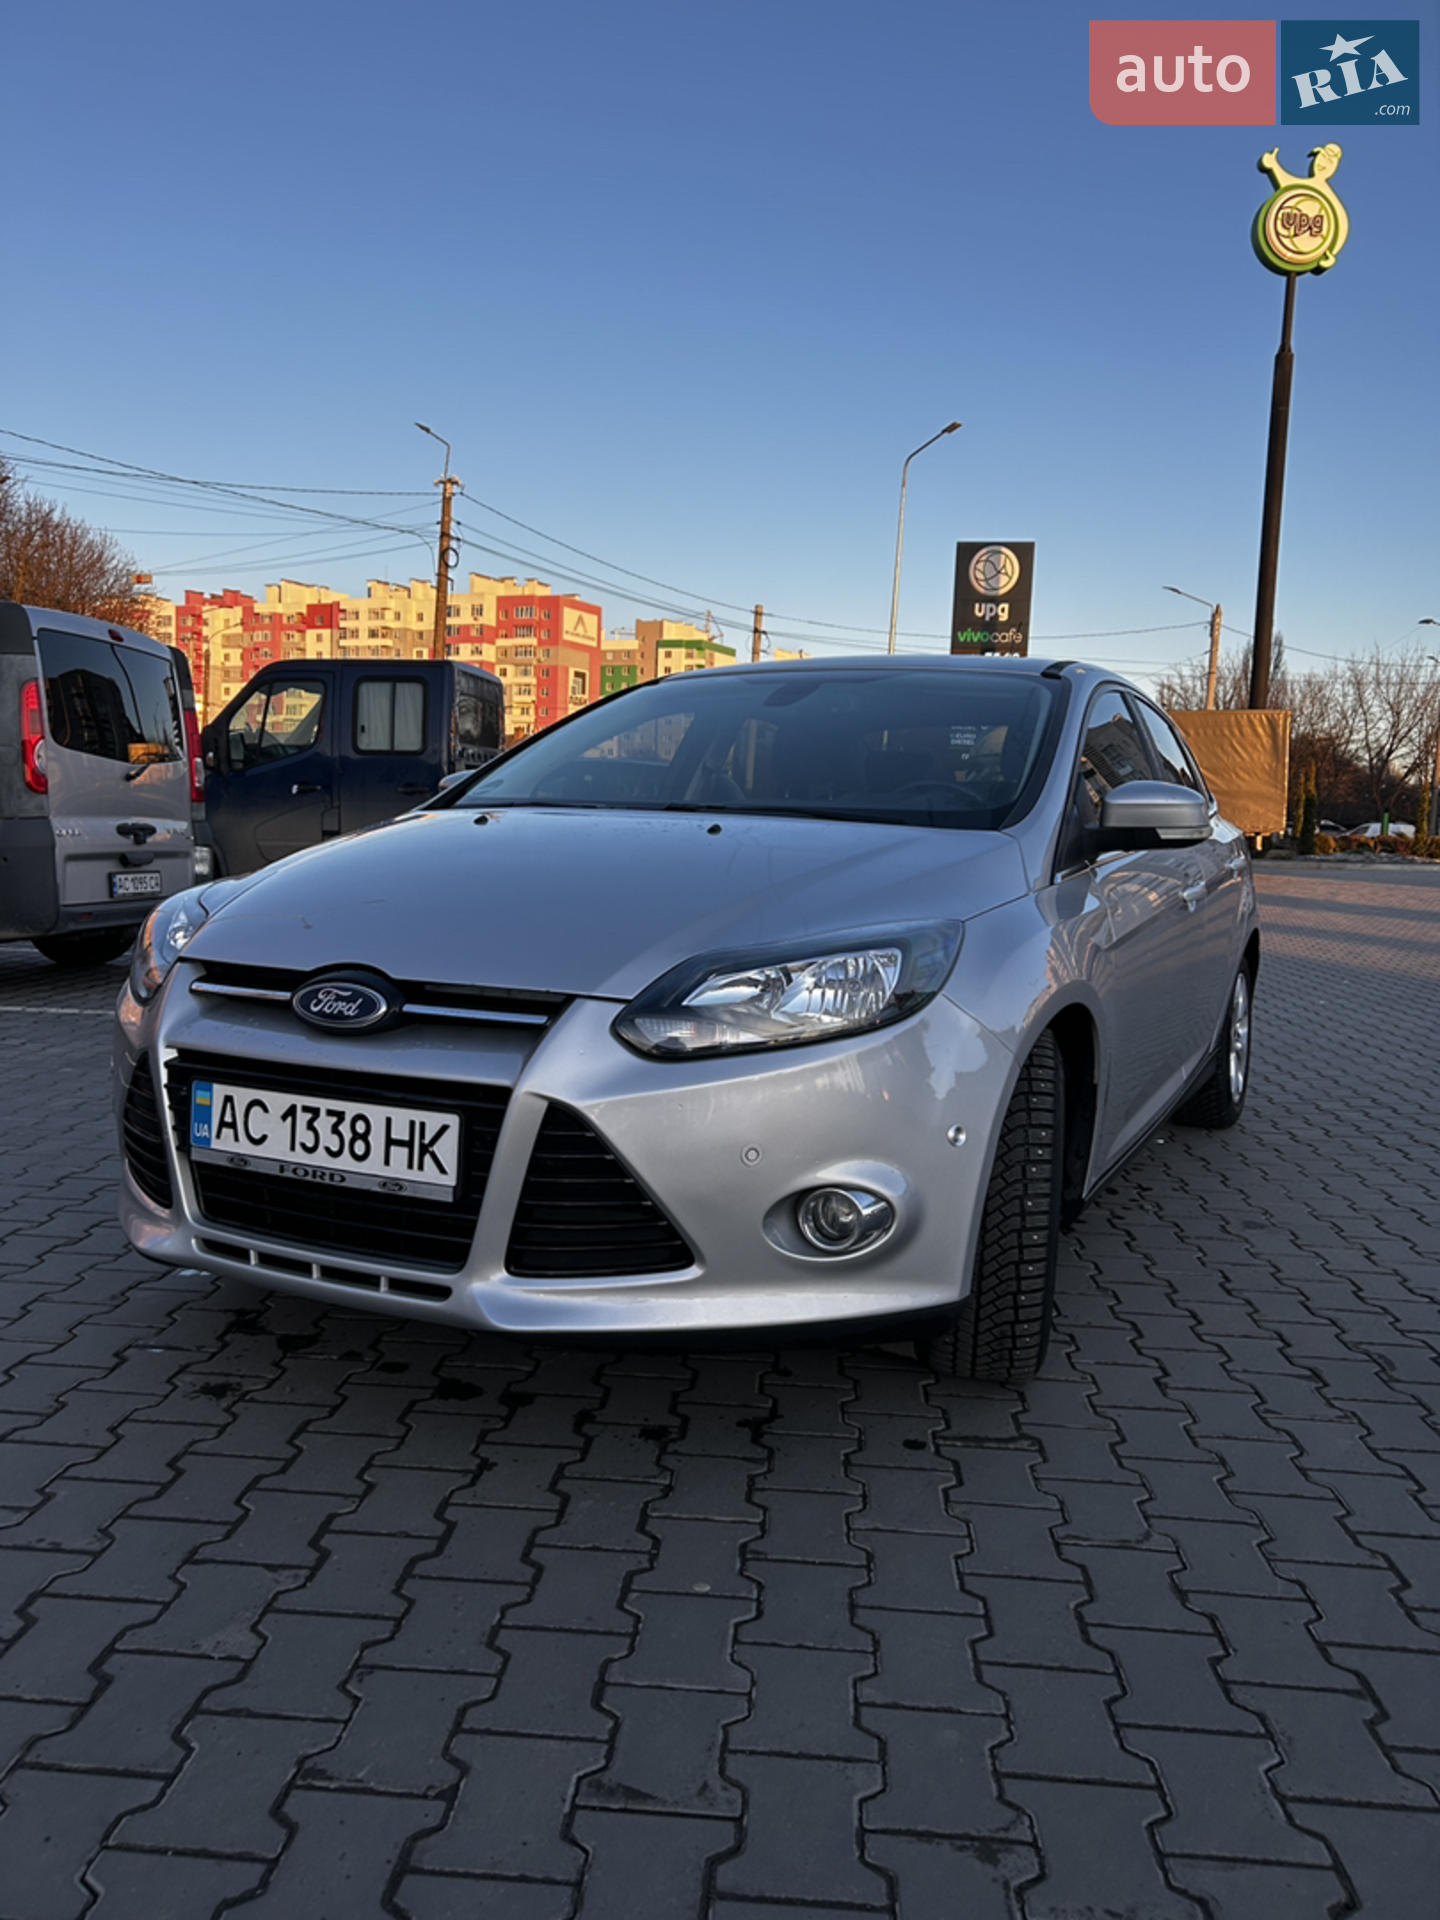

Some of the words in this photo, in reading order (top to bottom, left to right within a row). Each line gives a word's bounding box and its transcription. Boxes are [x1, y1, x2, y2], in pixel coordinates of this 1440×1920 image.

[1281, 212, 1324, 237] upg
[974, 602, 1010, 621] upg
[310, 987, 363, 1016] Ford
[194, 1122, 210, 1138] UA
[215, 1094, 270, 1146] AC
[281, 1103, 372, 1163] 1338
[383, 1116, 451, 1176] HK
[278, 1163, 347, 1184] FORD
